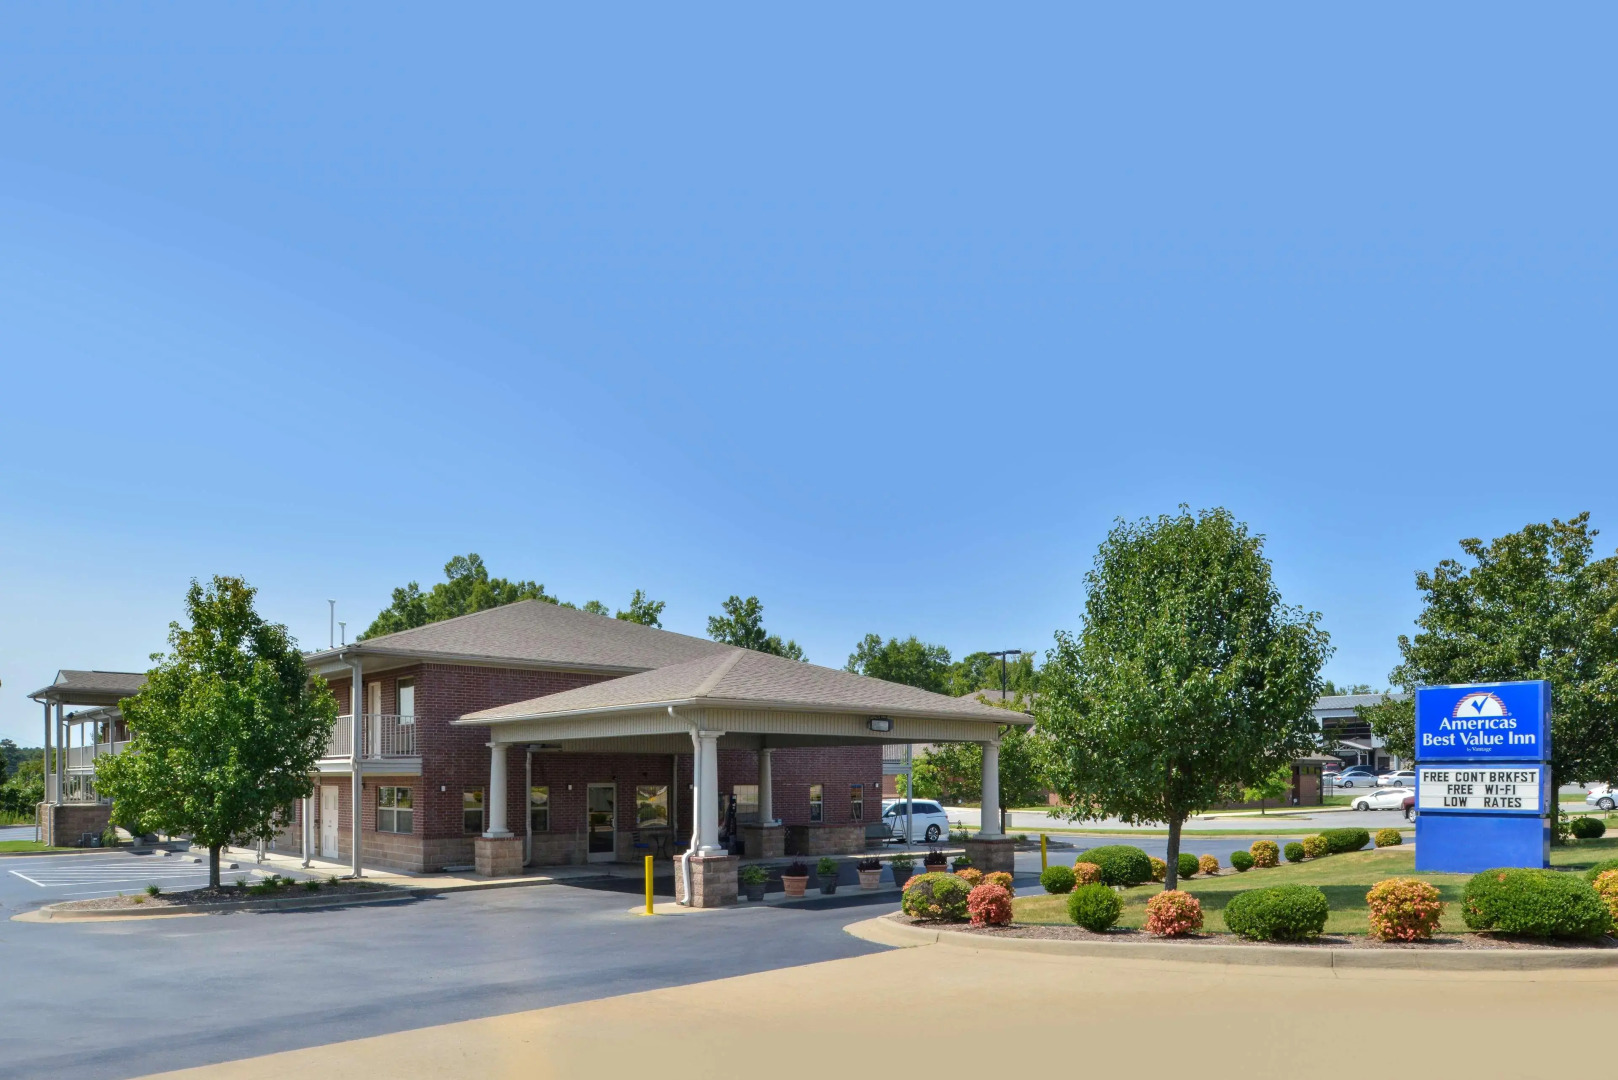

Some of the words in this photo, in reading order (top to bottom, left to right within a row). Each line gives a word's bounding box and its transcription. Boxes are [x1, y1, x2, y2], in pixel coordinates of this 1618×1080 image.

[1439, 717, 1517, 730] Americas
[1423, 733, 1456, 746] Best
[1459, 731, 1504, 745] Value
[1508, 731, 1536, 744] Inn
[1423, 772, 1449, 782] FREE
[1455, 772, 1486, 782] CONT
[1489, 772, 1536, 782] BRKFST
[1447, 784, 1473, 794] FREE
[1485, 784, 1516, 795] WI-FI
[1444, 797, 1468, 807] LOW
[1484, 797, 1522, 807] RATES
